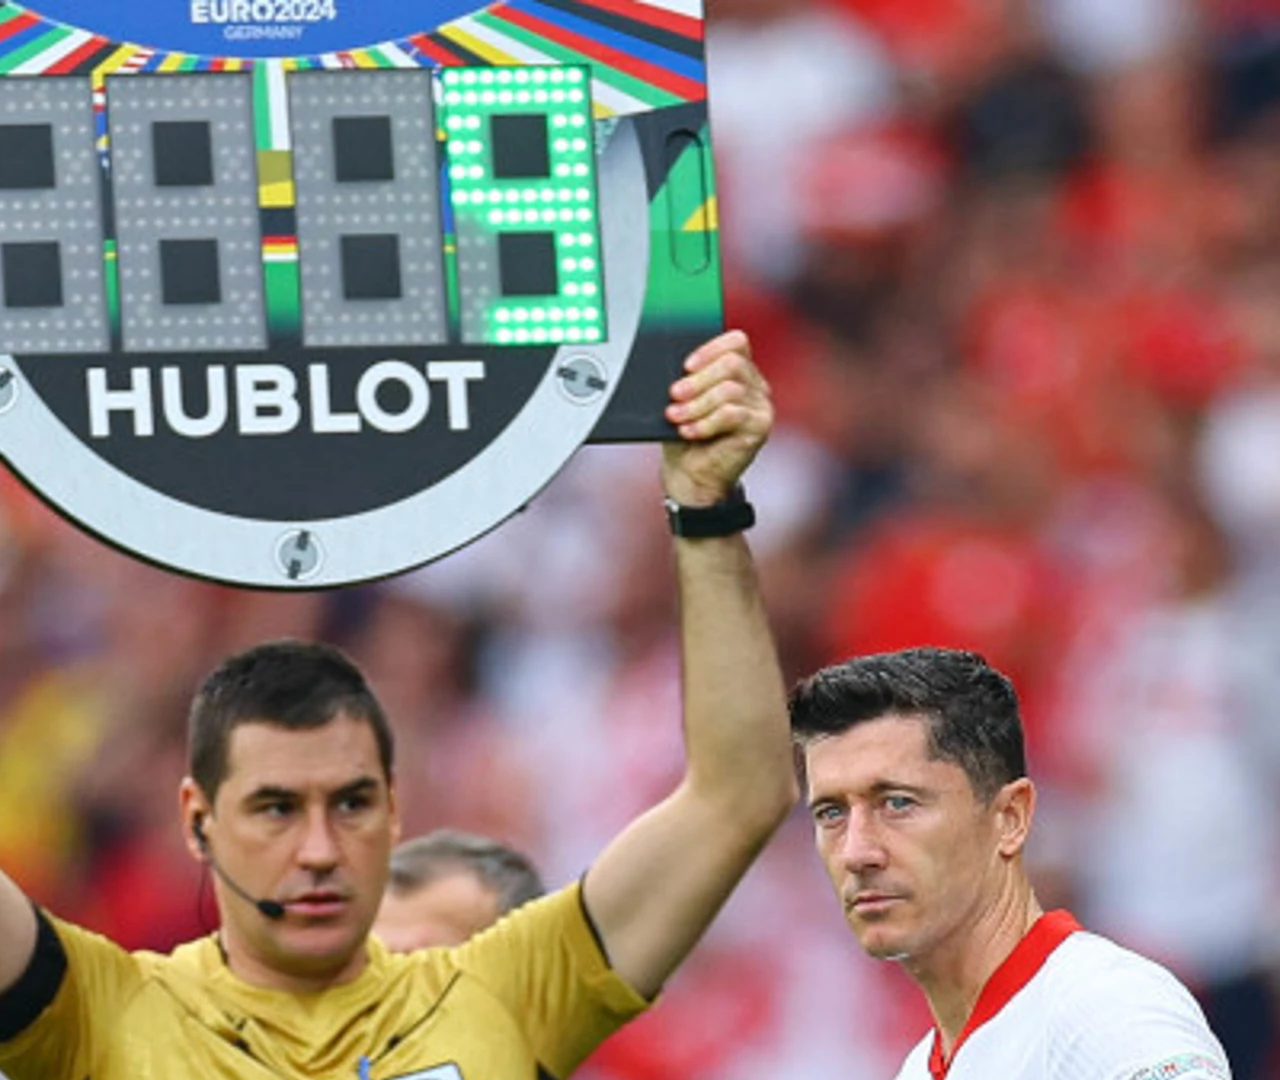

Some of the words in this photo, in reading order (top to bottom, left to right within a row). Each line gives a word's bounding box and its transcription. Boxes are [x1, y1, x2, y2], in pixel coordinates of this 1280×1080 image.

[190, 0, 337, 23] EURO2024
[223, 25, 304, 40] GERMANY
[442, 66, 606, 344] 9
[87, 360, 484, 436] HUBLOT
